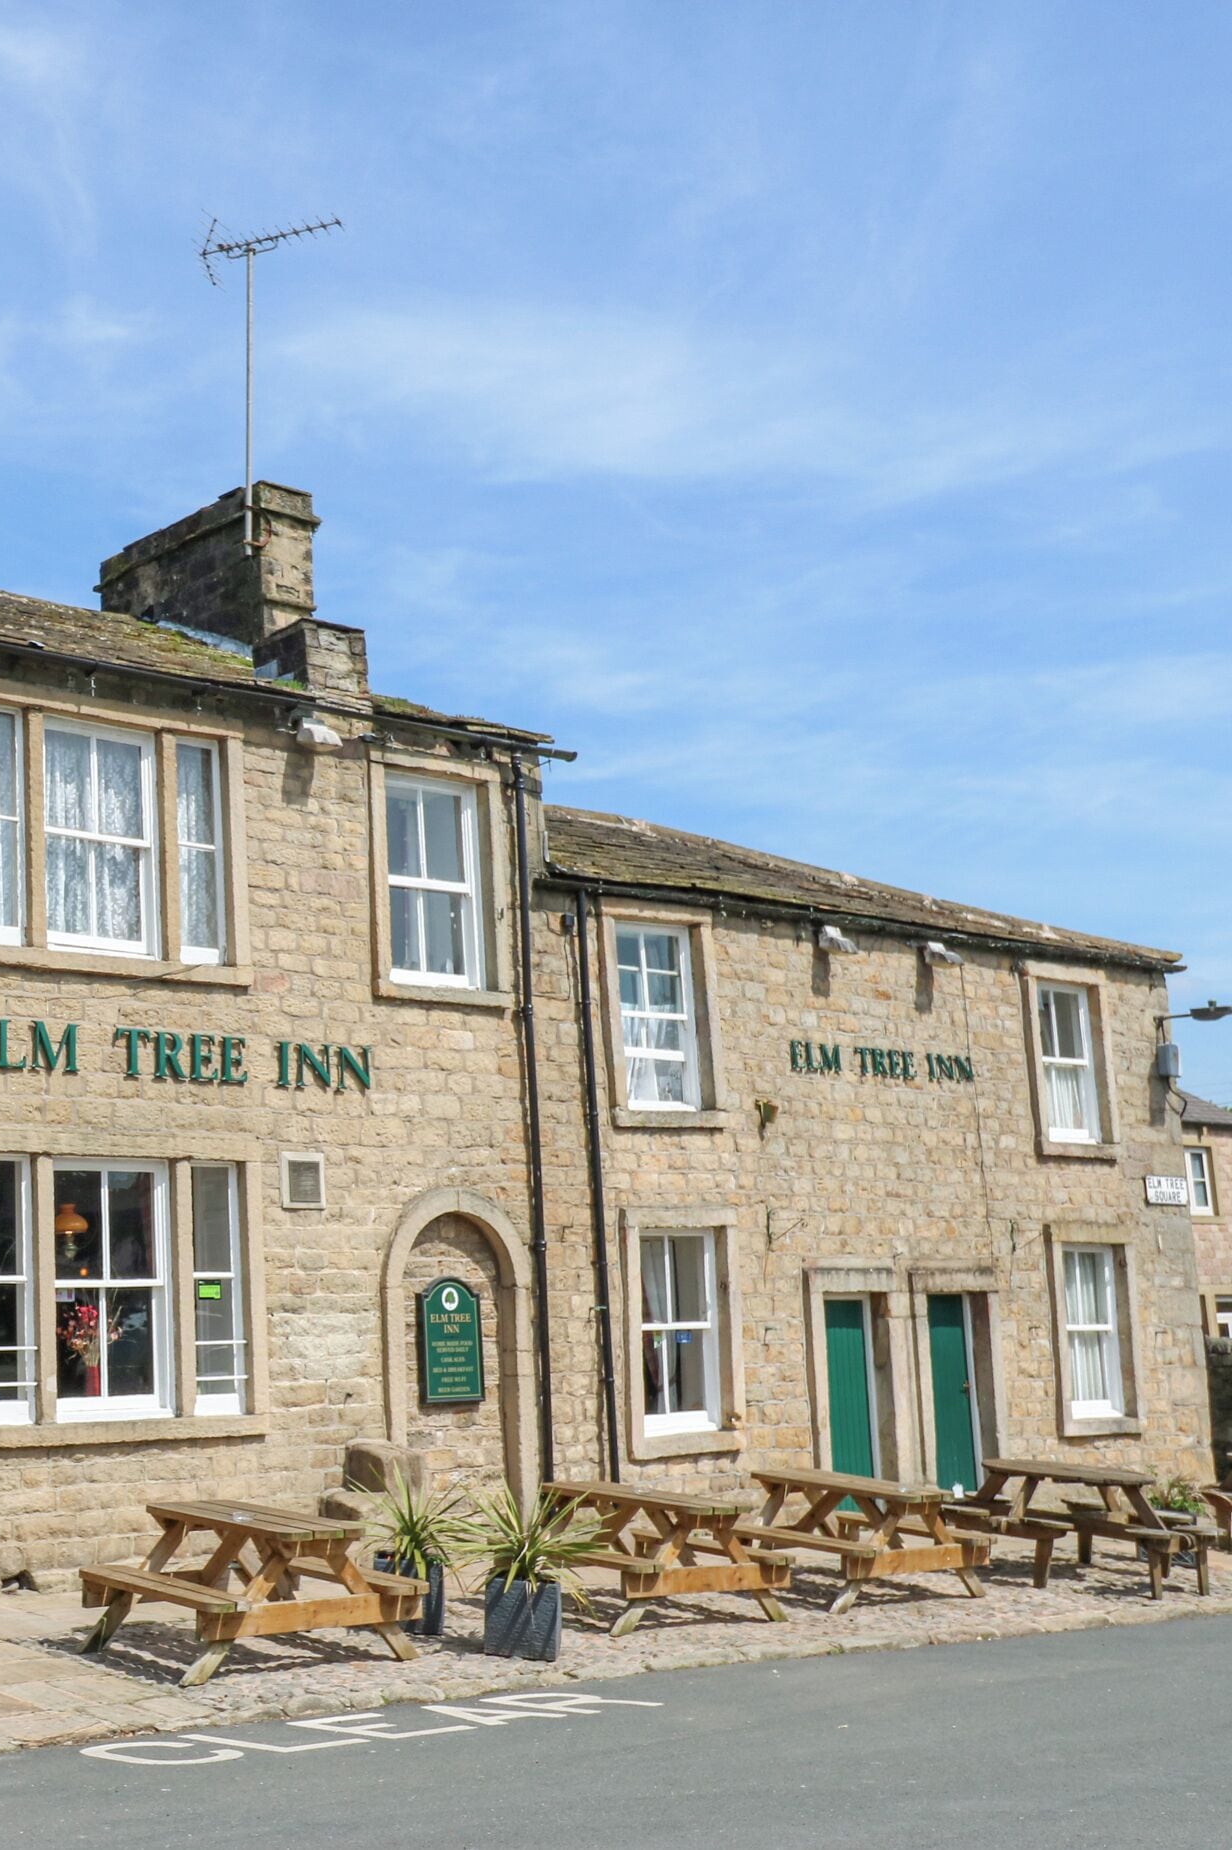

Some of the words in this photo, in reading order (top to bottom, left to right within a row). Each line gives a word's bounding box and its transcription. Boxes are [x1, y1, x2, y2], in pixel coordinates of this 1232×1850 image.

[115, 1027, 248, 1084] TREE
[276, 1040, 373, 1090] INN
[789, 1039, 842, 1073] ELM
[854, 1046, 917, 1081] TREE
[926, 1052, 975, 1083] INN
[1147, 1177, 1162, 1189] ELM
[1165, 1178, 1185, 1190] TREE
[1154, 1190, 1182, 1203] SQUARE
[430, 1313, 448, 1323] ELM
[450, 1313, 471, 1323] TREE
[444, 1324, 460, 1333] INN
[79, 1692, 664, 1766] CLEAR
